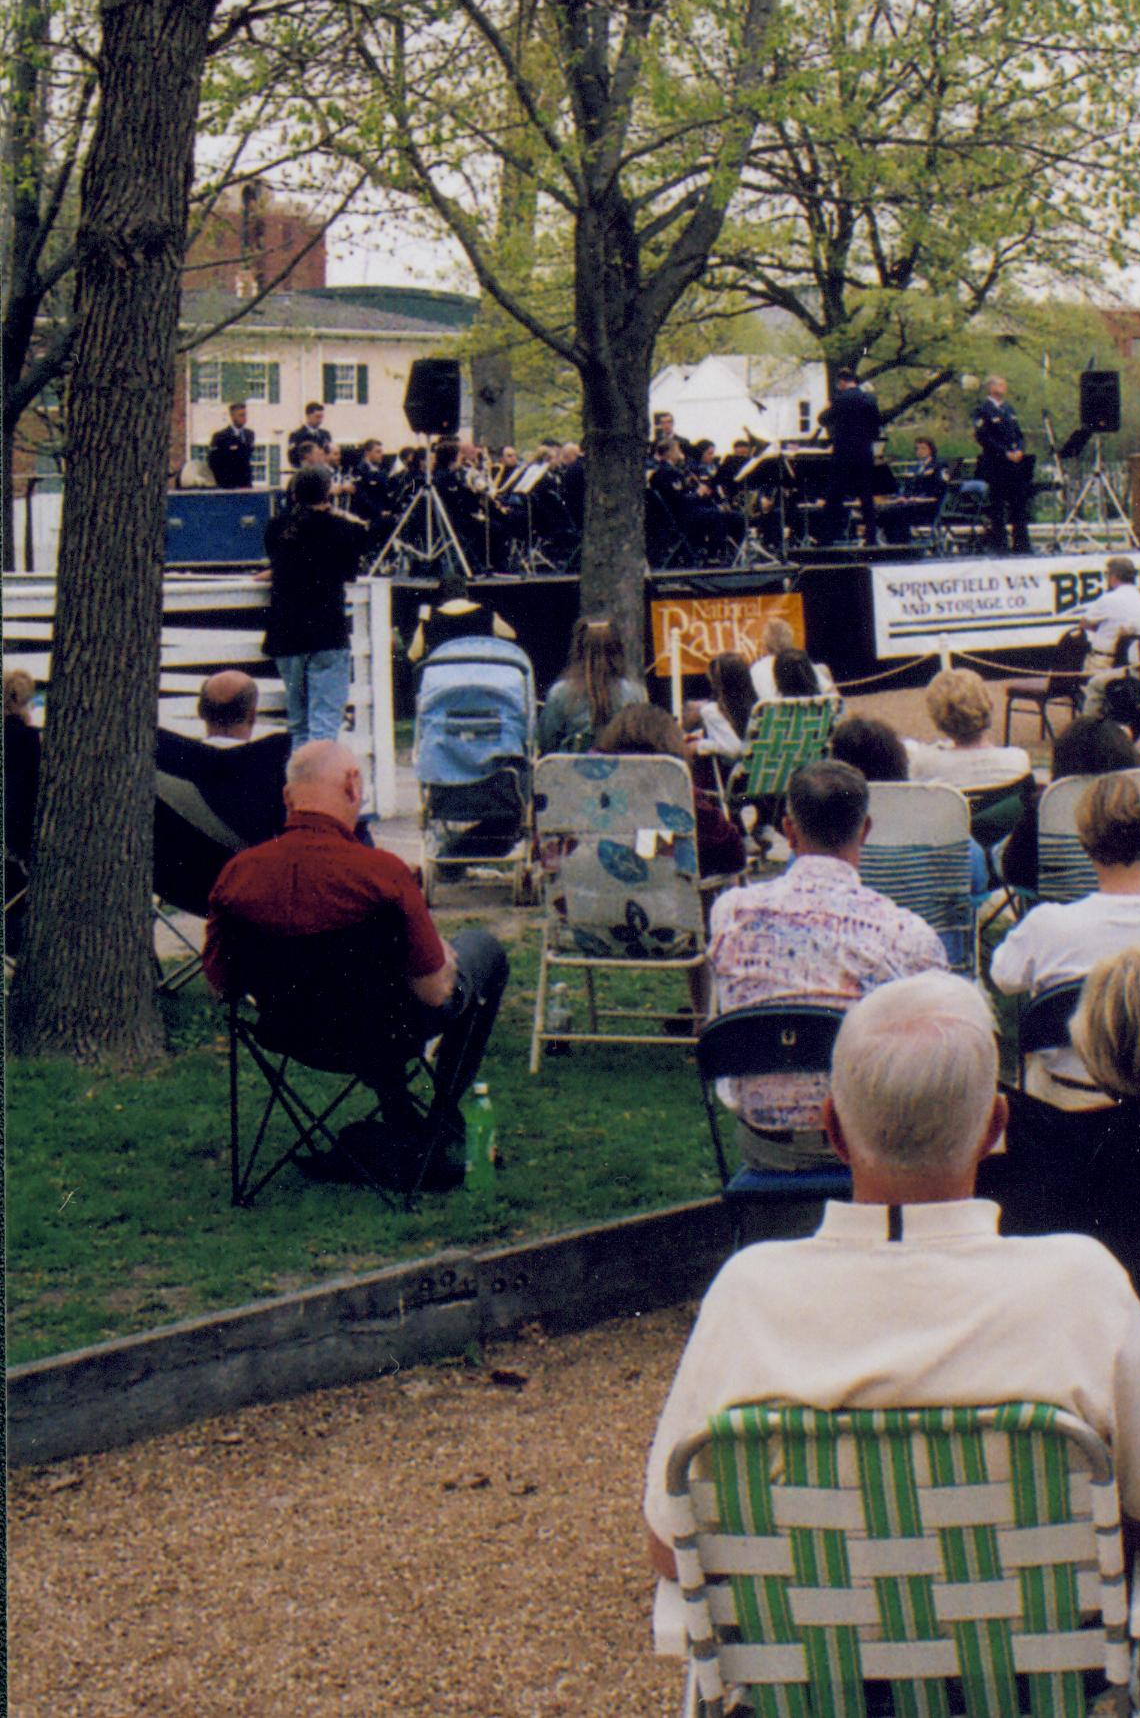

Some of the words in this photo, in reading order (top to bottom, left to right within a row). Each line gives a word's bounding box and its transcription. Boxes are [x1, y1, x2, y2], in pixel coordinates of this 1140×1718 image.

[886, 577, 1000, 600] SPRINGFIELD
[1005, 574, 1040, 590] VAN
[692, 596, 762, 619] National
[901, 602, 931, 615] AND
[935, 596, 1003, 614] STORAGE
